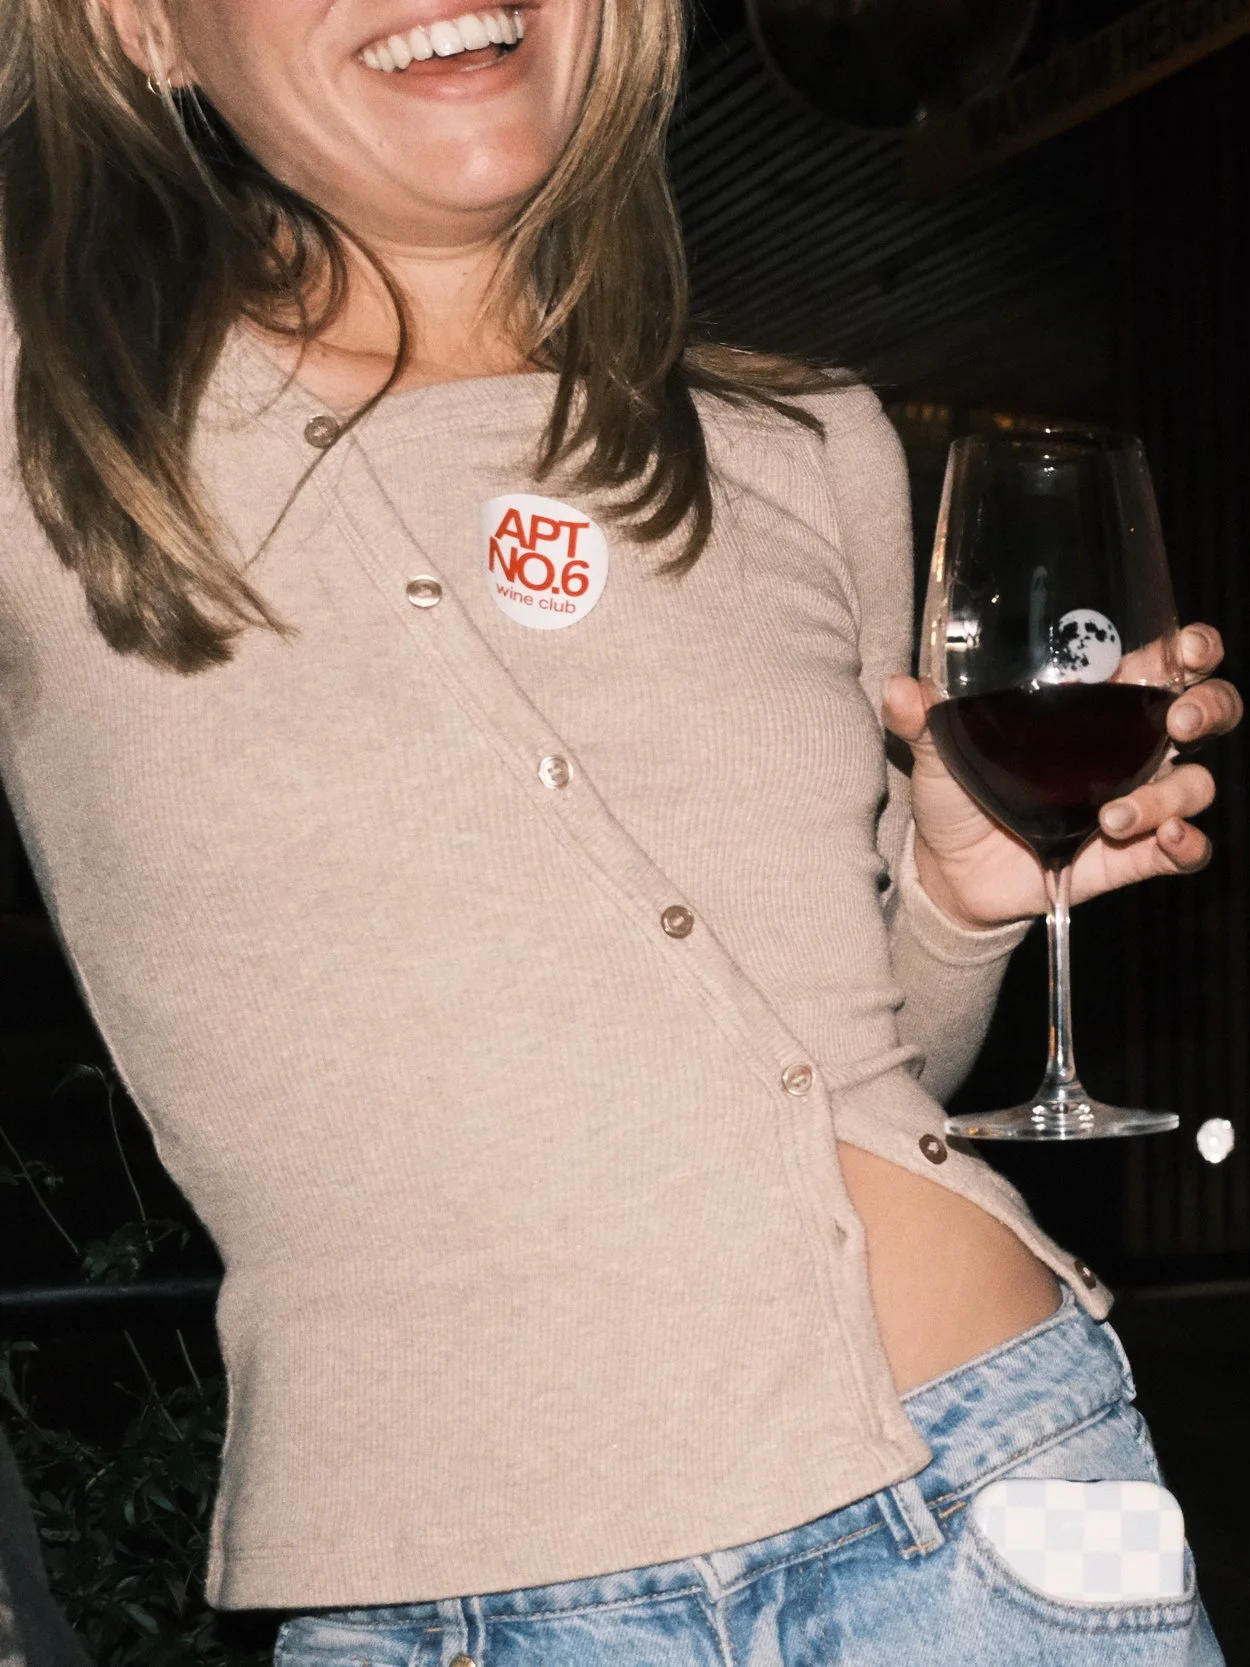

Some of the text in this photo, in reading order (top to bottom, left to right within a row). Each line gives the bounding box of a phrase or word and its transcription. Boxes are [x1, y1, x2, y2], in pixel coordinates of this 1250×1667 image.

[495, 507, 590, 558] APT
[488, 536, 590, 597] NO.6
[496, 582, 576, 614] wine club
